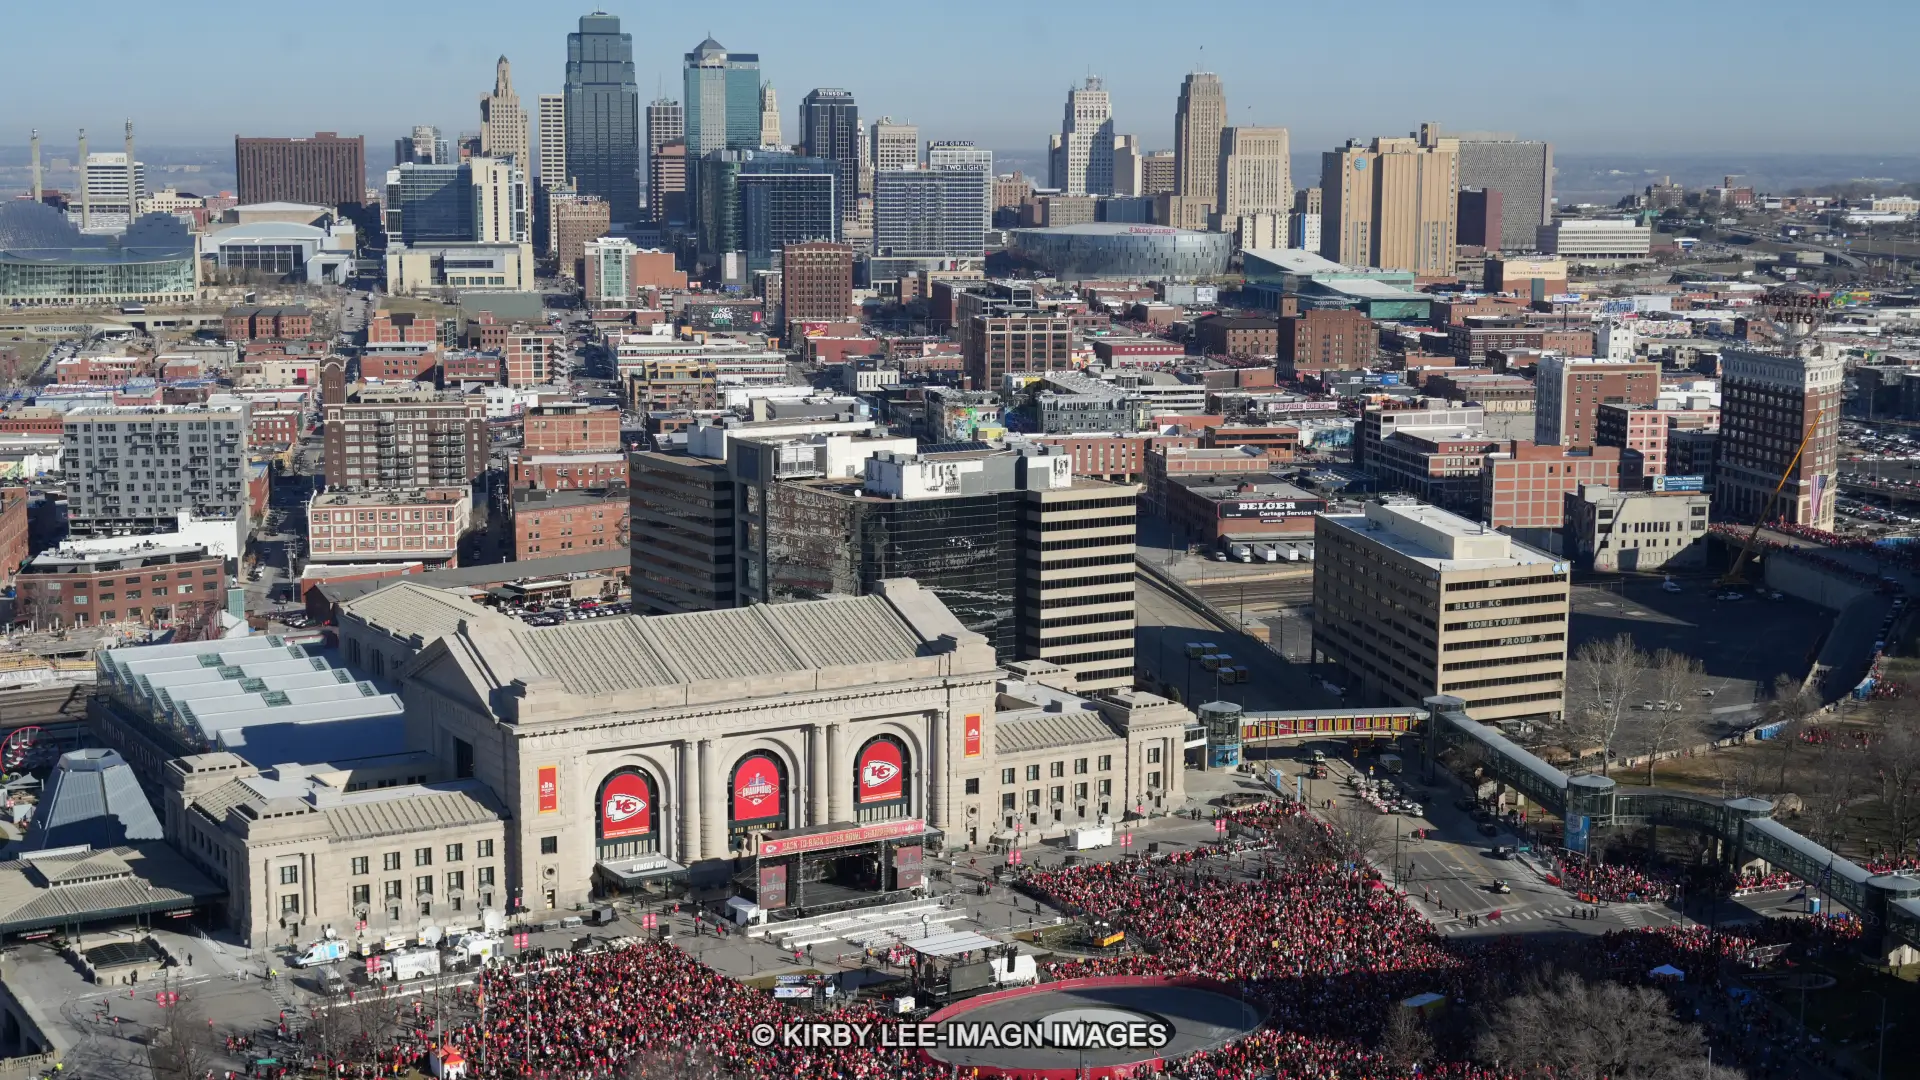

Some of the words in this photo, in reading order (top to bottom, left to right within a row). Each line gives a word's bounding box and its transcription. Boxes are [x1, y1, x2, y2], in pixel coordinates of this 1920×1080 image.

[747, 150, 754, 161] 3
[1759, 293, 1829, 308] WESTERN
[1774, 311, 1814, 324] AUTO
[1238, 502, 1296, 510] BELGER
[1455, 602, 1480, 610] BLUE
[1488, 599, 1501, 607] KC
[1467, 618, 1521, 629] HOMETOWN
[1500, 636, 1533, 645] PROUD
